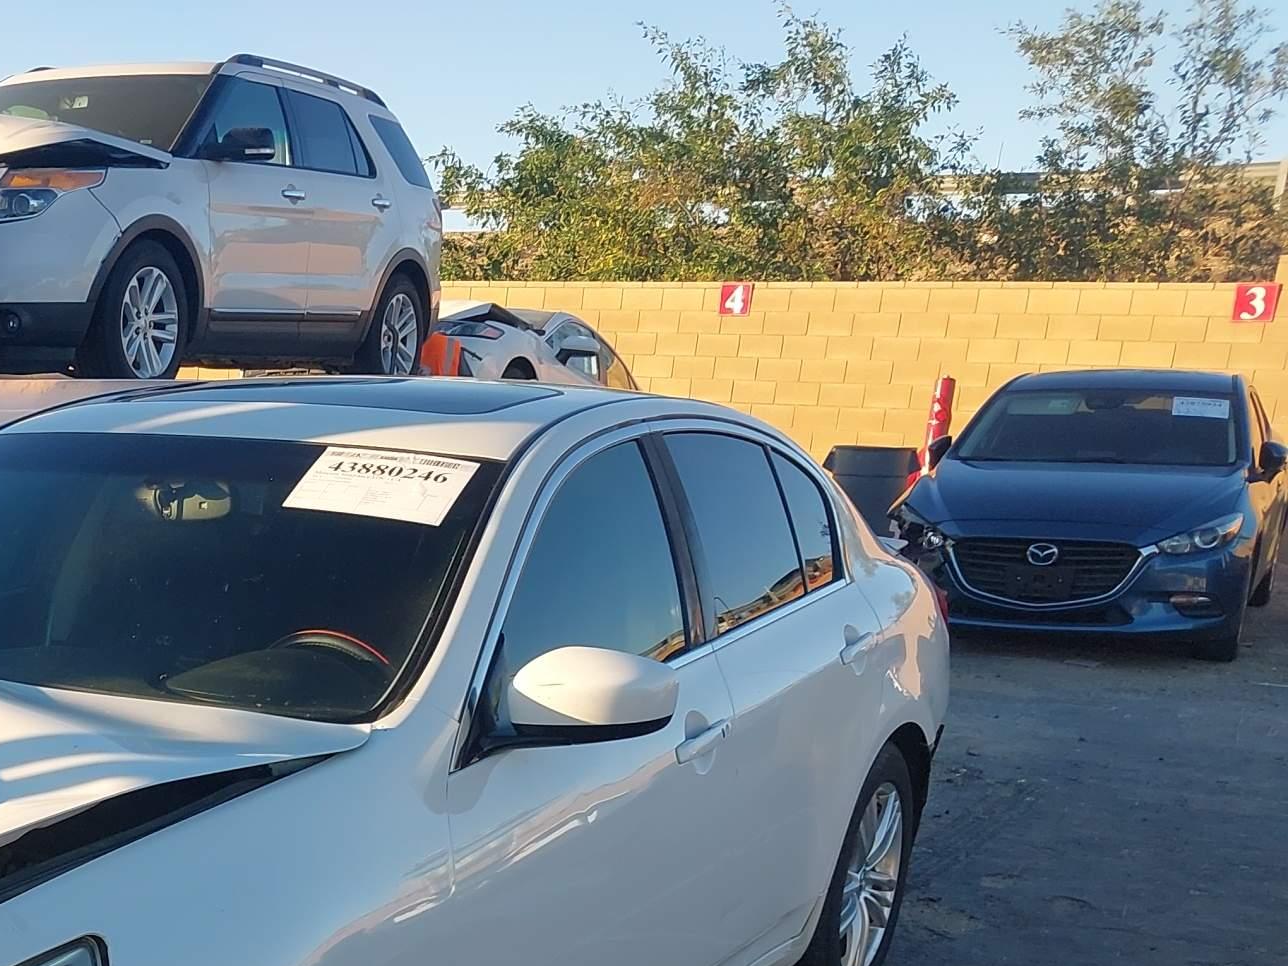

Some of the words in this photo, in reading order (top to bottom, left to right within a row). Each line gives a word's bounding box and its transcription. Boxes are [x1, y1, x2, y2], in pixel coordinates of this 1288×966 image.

[724, 284, 744, 314] 4
[1239, 286, 1266, 320] 3
[328, 460, 452, 484] 43880246
